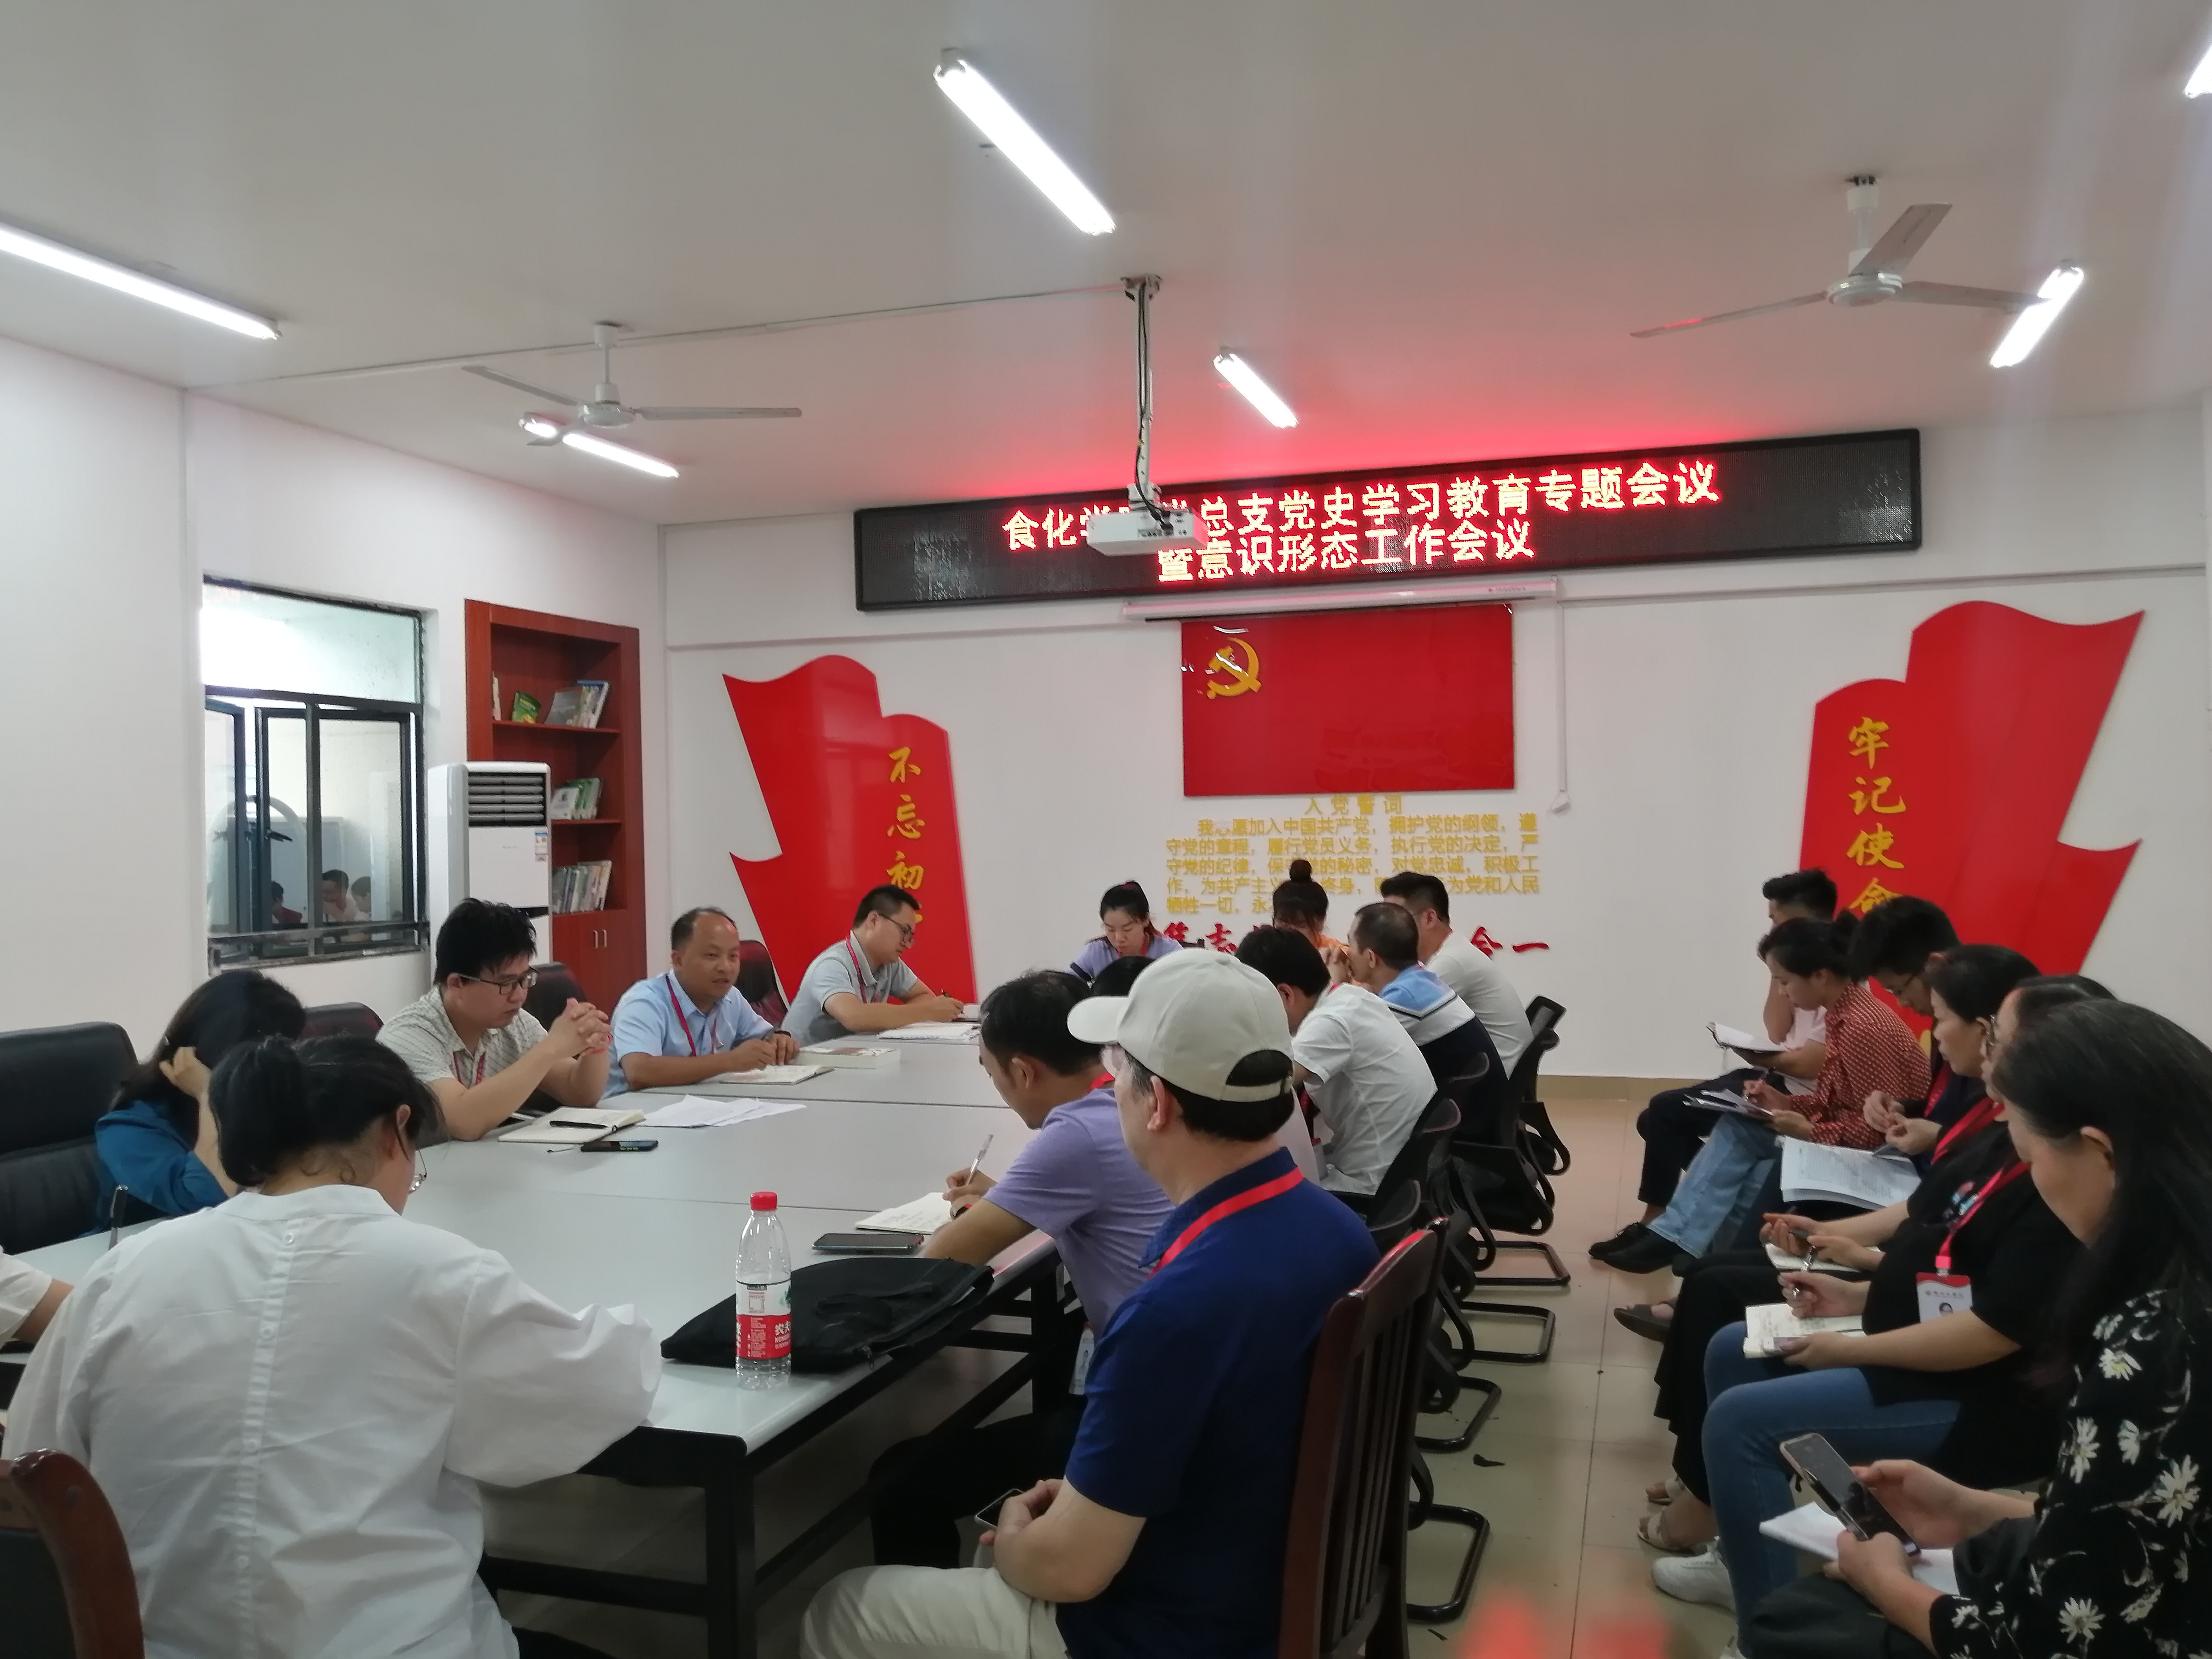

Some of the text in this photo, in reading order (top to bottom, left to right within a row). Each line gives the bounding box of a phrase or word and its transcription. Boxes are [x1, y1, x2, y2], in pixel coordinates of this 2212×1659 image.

[1002, 460, 1719, 551] 食化总支党史学习教育专题会议
[1157, 517, 1534, 582] 暨意识形态工作会议
[886, 747, 926, 923] 不忘初
[1305, 793, 1401, 816] 入党誓词
